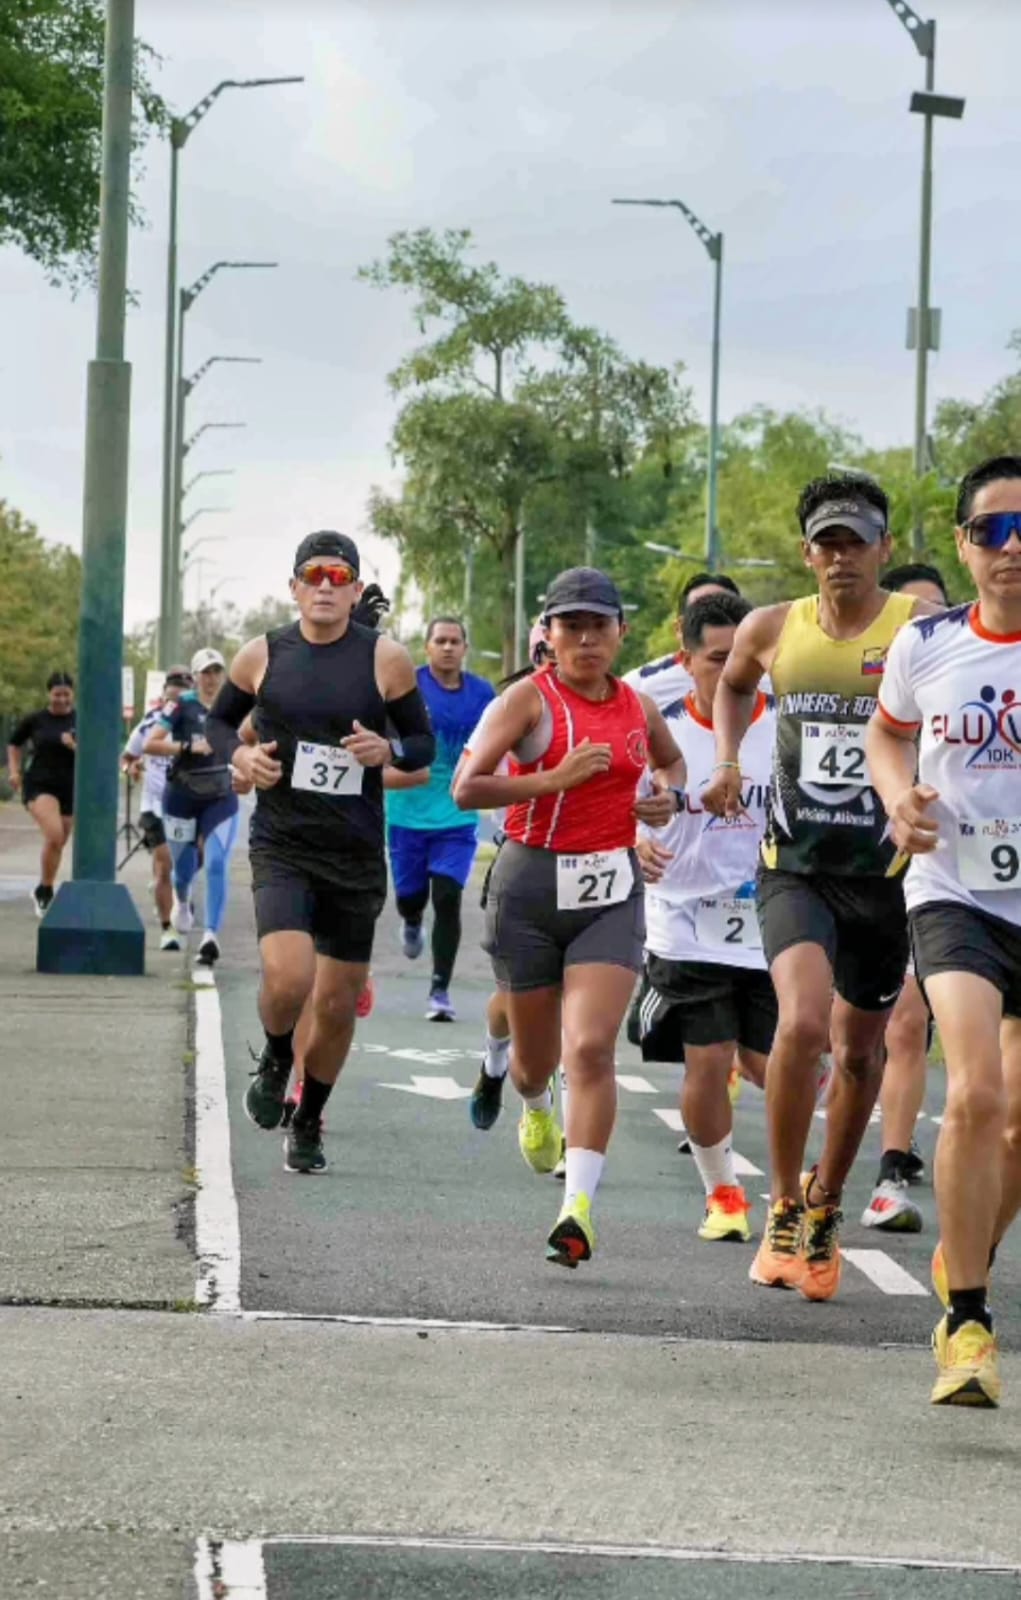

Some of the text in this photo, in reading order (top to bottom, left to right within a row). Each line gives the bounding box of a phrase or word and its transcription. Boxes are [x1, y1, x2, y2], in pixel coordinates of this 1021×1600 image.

[819, 746, 865, 778] 42
[987, 748, 1014, 762] 10K
[310, 761, 349, 789] 37
[991, 844, 1020, 882] 9
[578, 868, 617, 903] 27
[724, 917, 744, 943] 2
